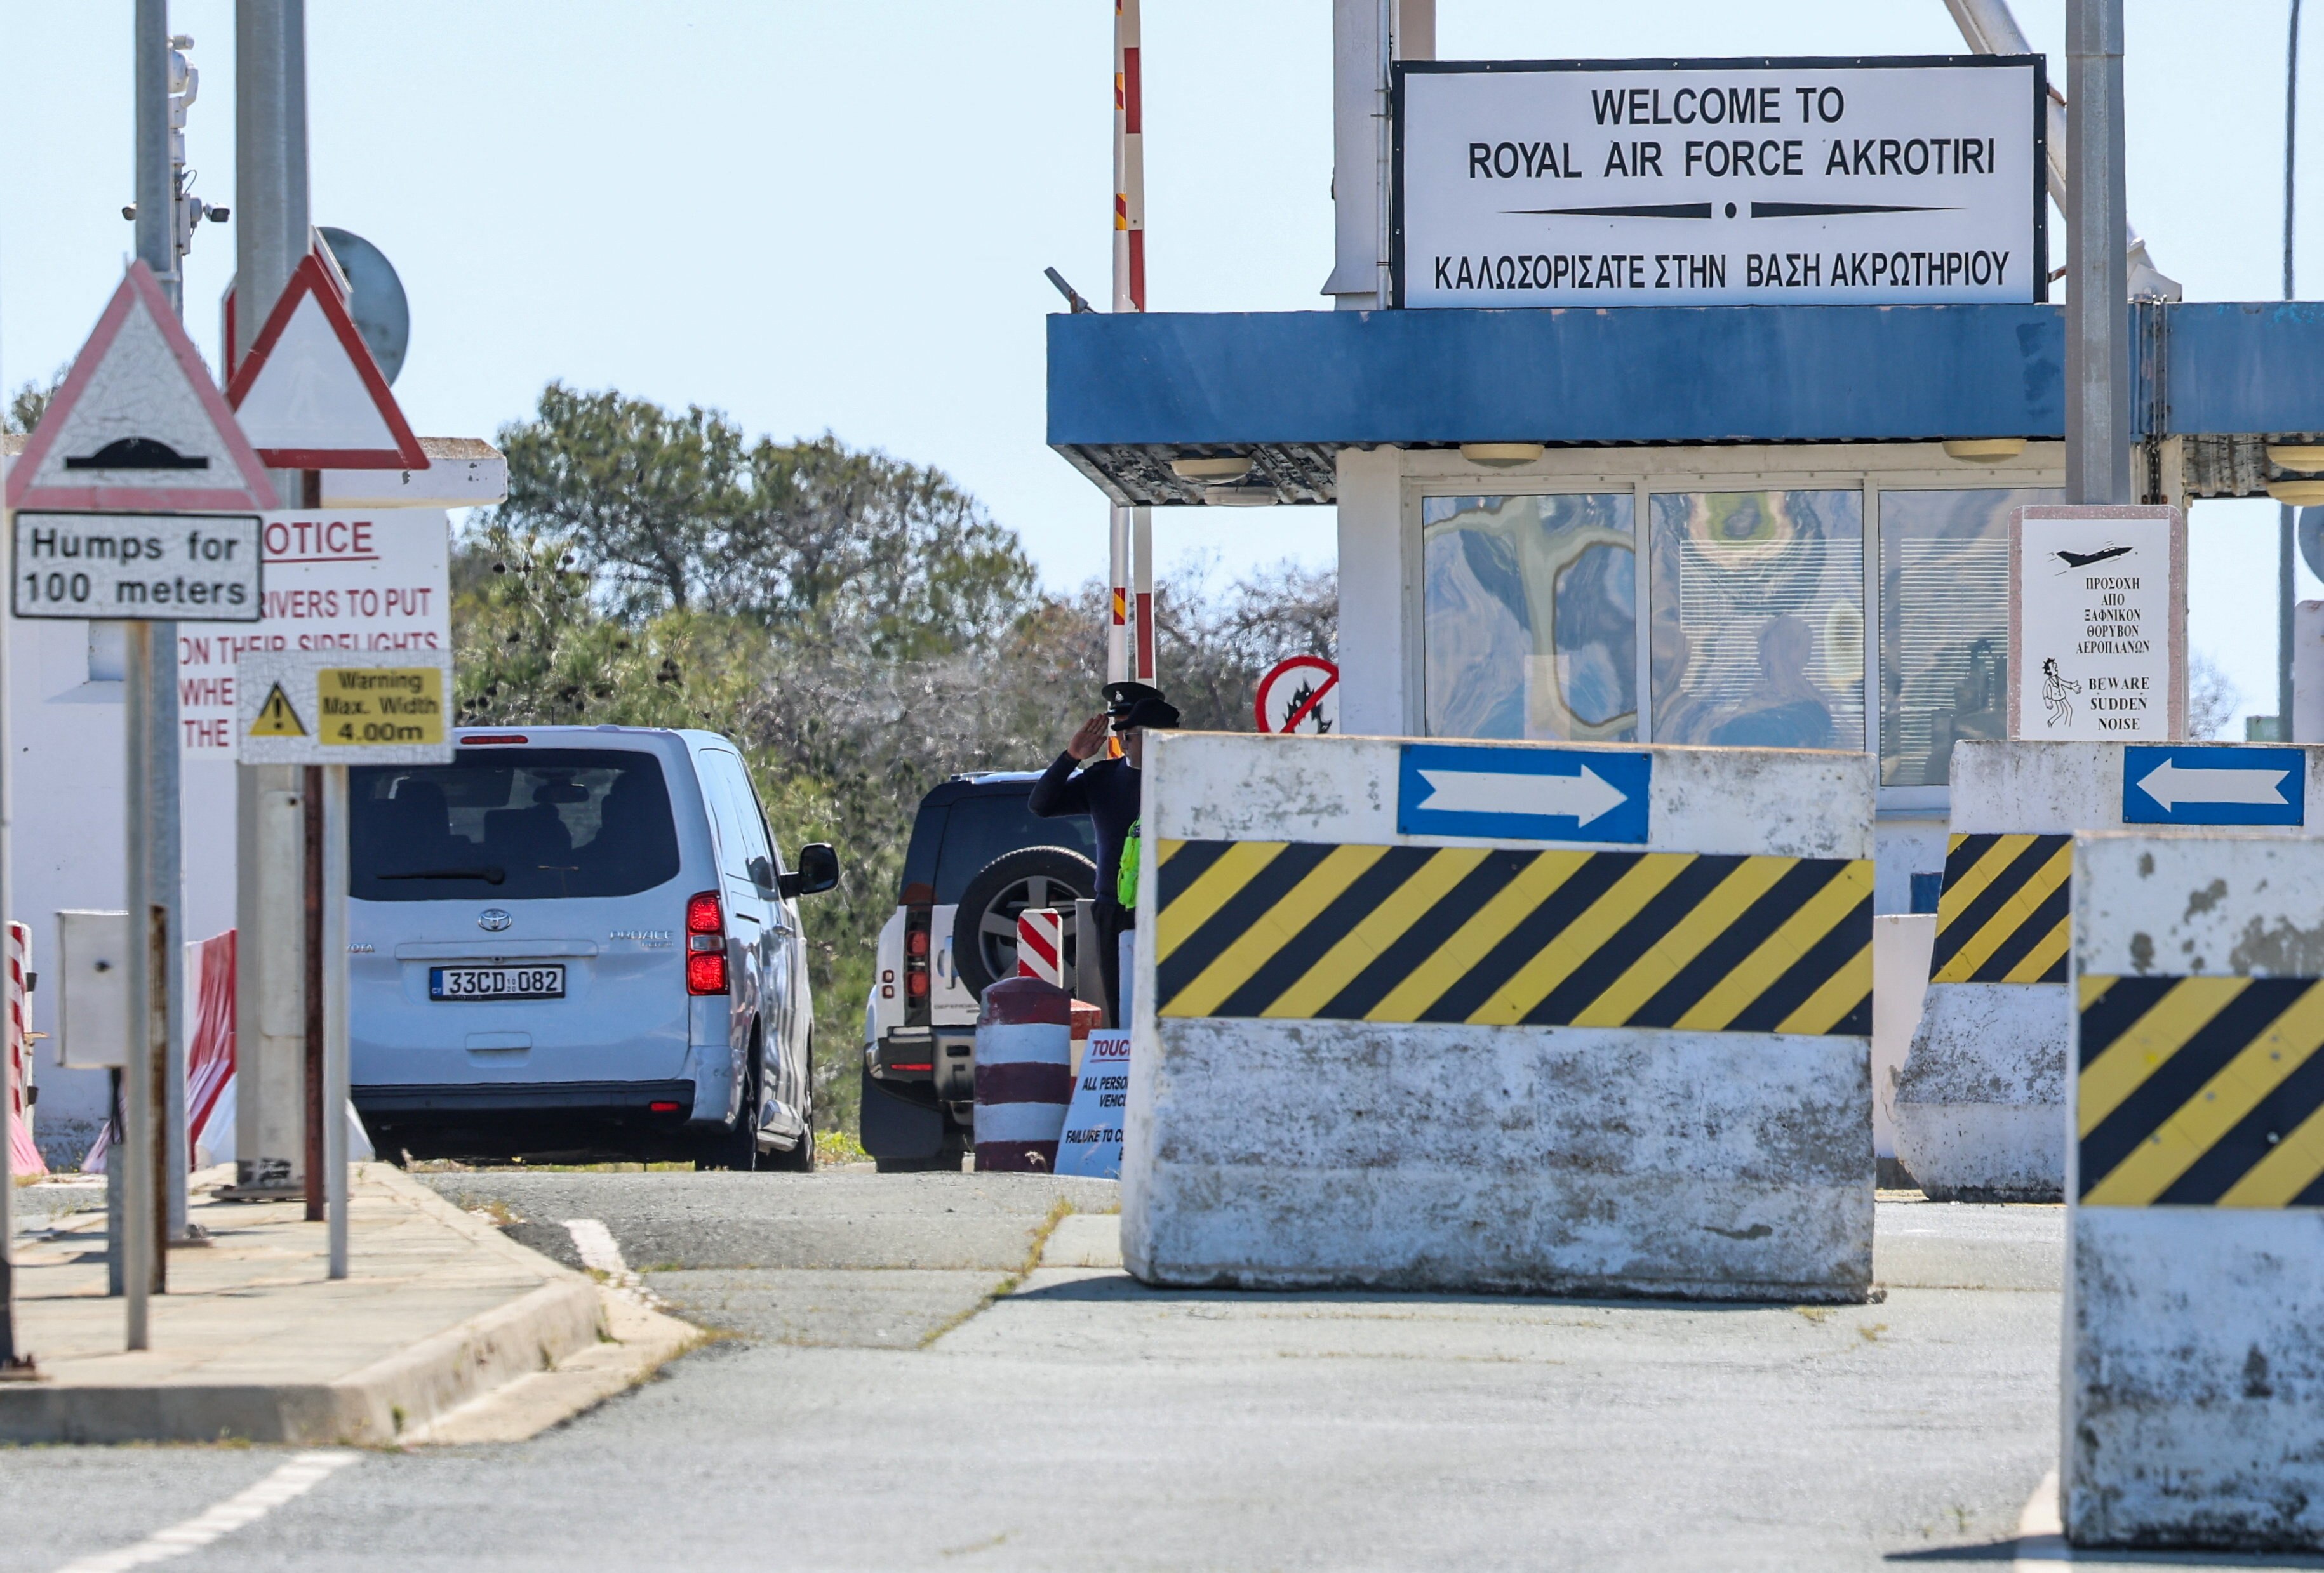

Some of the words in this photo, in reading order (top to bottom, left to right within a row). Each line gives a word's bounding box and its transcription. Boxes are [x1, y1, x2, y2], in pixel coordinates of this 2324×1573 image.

[1592, 87, 1780, 125] WELCOME
[1795, 86, 1844, 123] TO
[1469, 142, 1582, 178] ROYAL
[1603, 141, 1662, 177] AIR
[1685, 140, 1803, 176] FORCE
[1826, 138, 1994, 175] AKROTIRI
[1434, 255, 1645, 289] ΚΑΛΩΣΟΡΙΣΑΤΕ
[1655, 254, 1726, 288] ΣΤΗΝ
[1746, 253, 1820, 287] ΒΑΣΗ
[1831, 251, 2010, 286] ΑΚΡΩΤΗΡΙΟΥ
[32, 528, 163, 565] Humps
[189, 531, 238, 560] for
[264, 522, 373, 554] OTICE
[25, 573, 90, 602] 100
[116, 576, 246, 604] meters
[2086, 578, 2140, 590] ΠΡΟΣΟΧΗ
[345, 589, 379, 617] TO
[385, 588, 432, 616] PUT
[2101, 594, 2125, 606] ΑΠΟ
[2084, 609, 2140, 621] ΞΑΦΝΙΚΟΝ
[2087, 625, 2139, 637] ΘΟΡΥΒΟΝ
[2076, 640, 2150, 654] ΑΕΡΟΠΛΑΝΩΝ
[180, 677, 234, 706] WHE
[338, 670, 424, 694] Warning
[2089, 677, 2149, 690] BEWARE
[323, 697, 371, 715] Max.
[379, 696, 439, 715] Width
[2090, 698, 2147, 710] SUDDEN
[183, 719, 229, 747] THE
[338, 722, 424, 741] 4.00m
[2098, 718, 2140, 730] NOISE
[450, 972, 505, 993] 33CD
[518, 971, 558, 992] 082
[1092, 1039, 1130, 1056] TOUC
[1082, 1077, 1097, 1091] ALL
[1100, 1076, 1128, 1090] PERSO
[1065, 1129, 1101, 1143] FAILURE
[1102, 1129, 1112, 1143] TO
